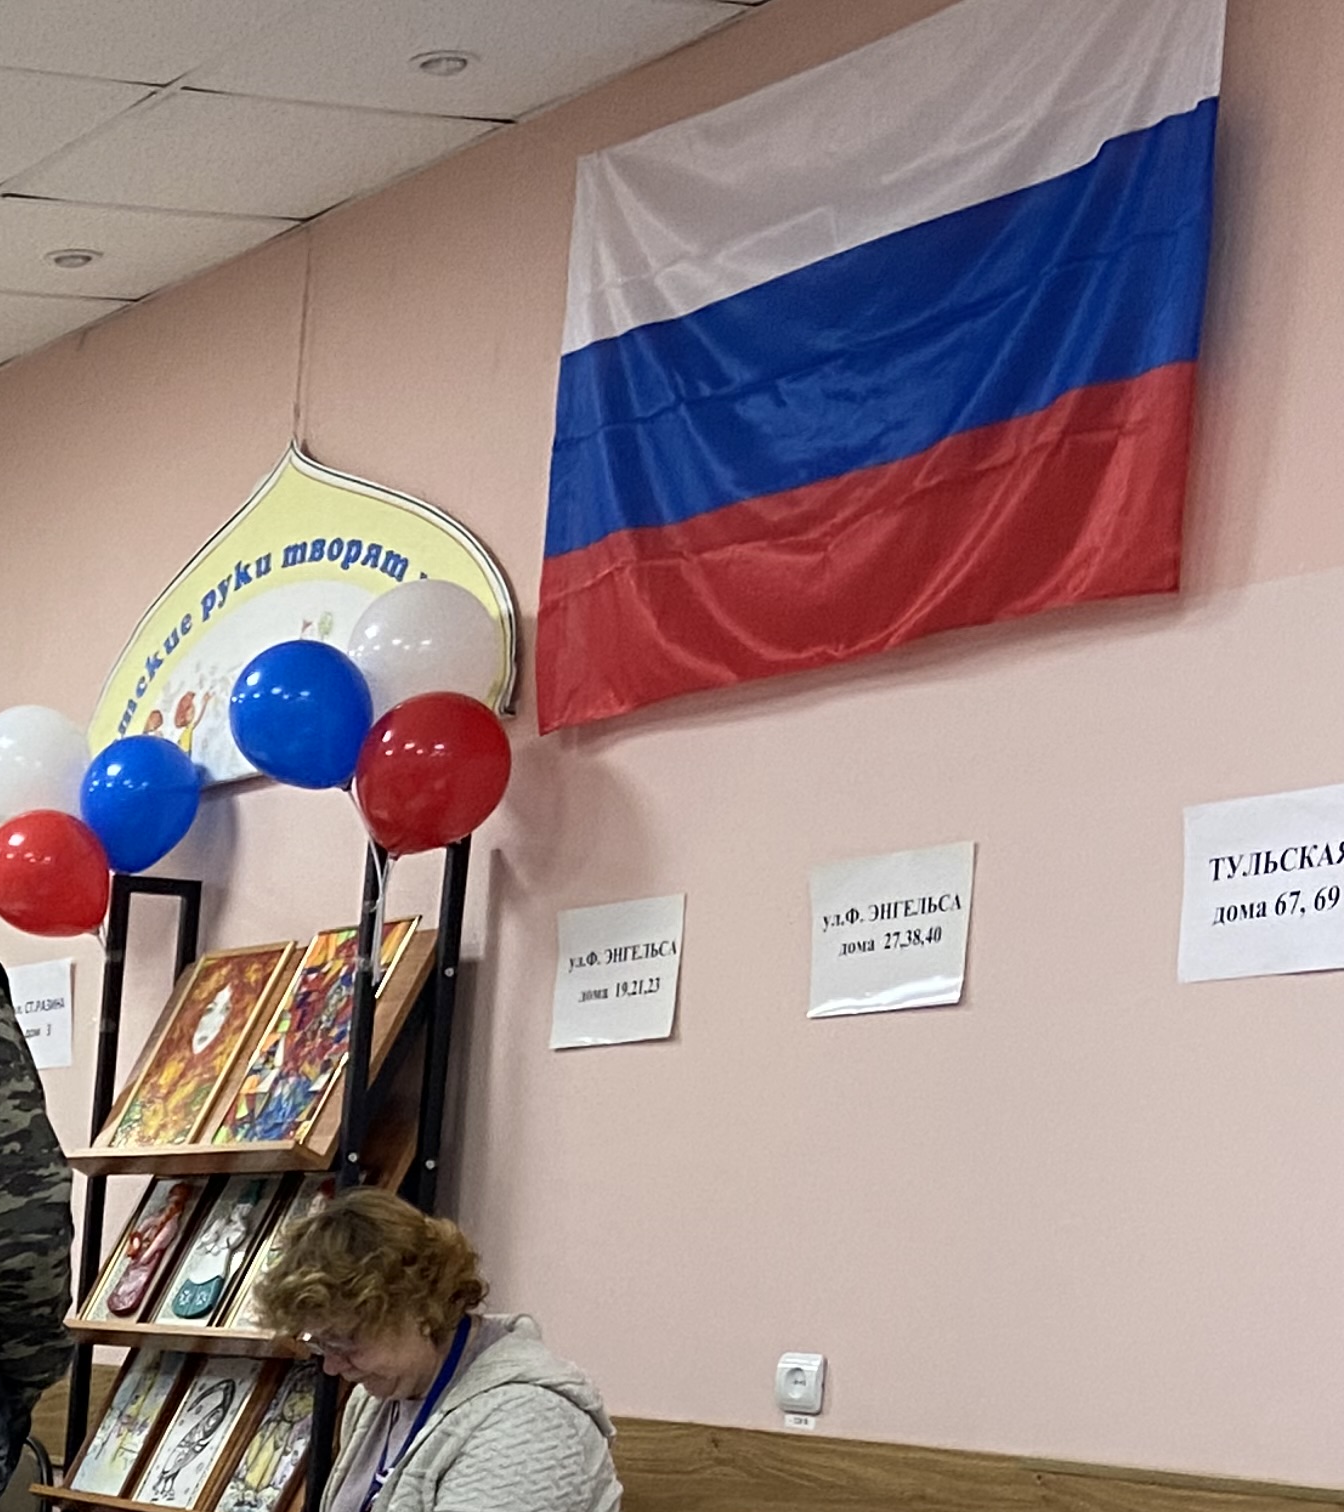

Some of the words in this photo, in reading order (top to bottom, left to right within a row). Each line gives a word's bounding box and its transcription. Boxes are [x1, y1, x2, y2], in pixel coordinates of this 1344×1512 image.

[117, 612, 192, 737] тские
[200, 553, 272, 623] руки
[281, 537, 410, 582] творят
[868, 893, 962, 923] ЭНГЕЛЬСА
[1212, 900, 1268, 926] дома
[1274, 890, 1306, 916] 67,
[1314, 884, 1341, 911] 69
[604, 939, 677, 965] ЭНГЕЛЬСА
[838, 939, 876, 957] дома
